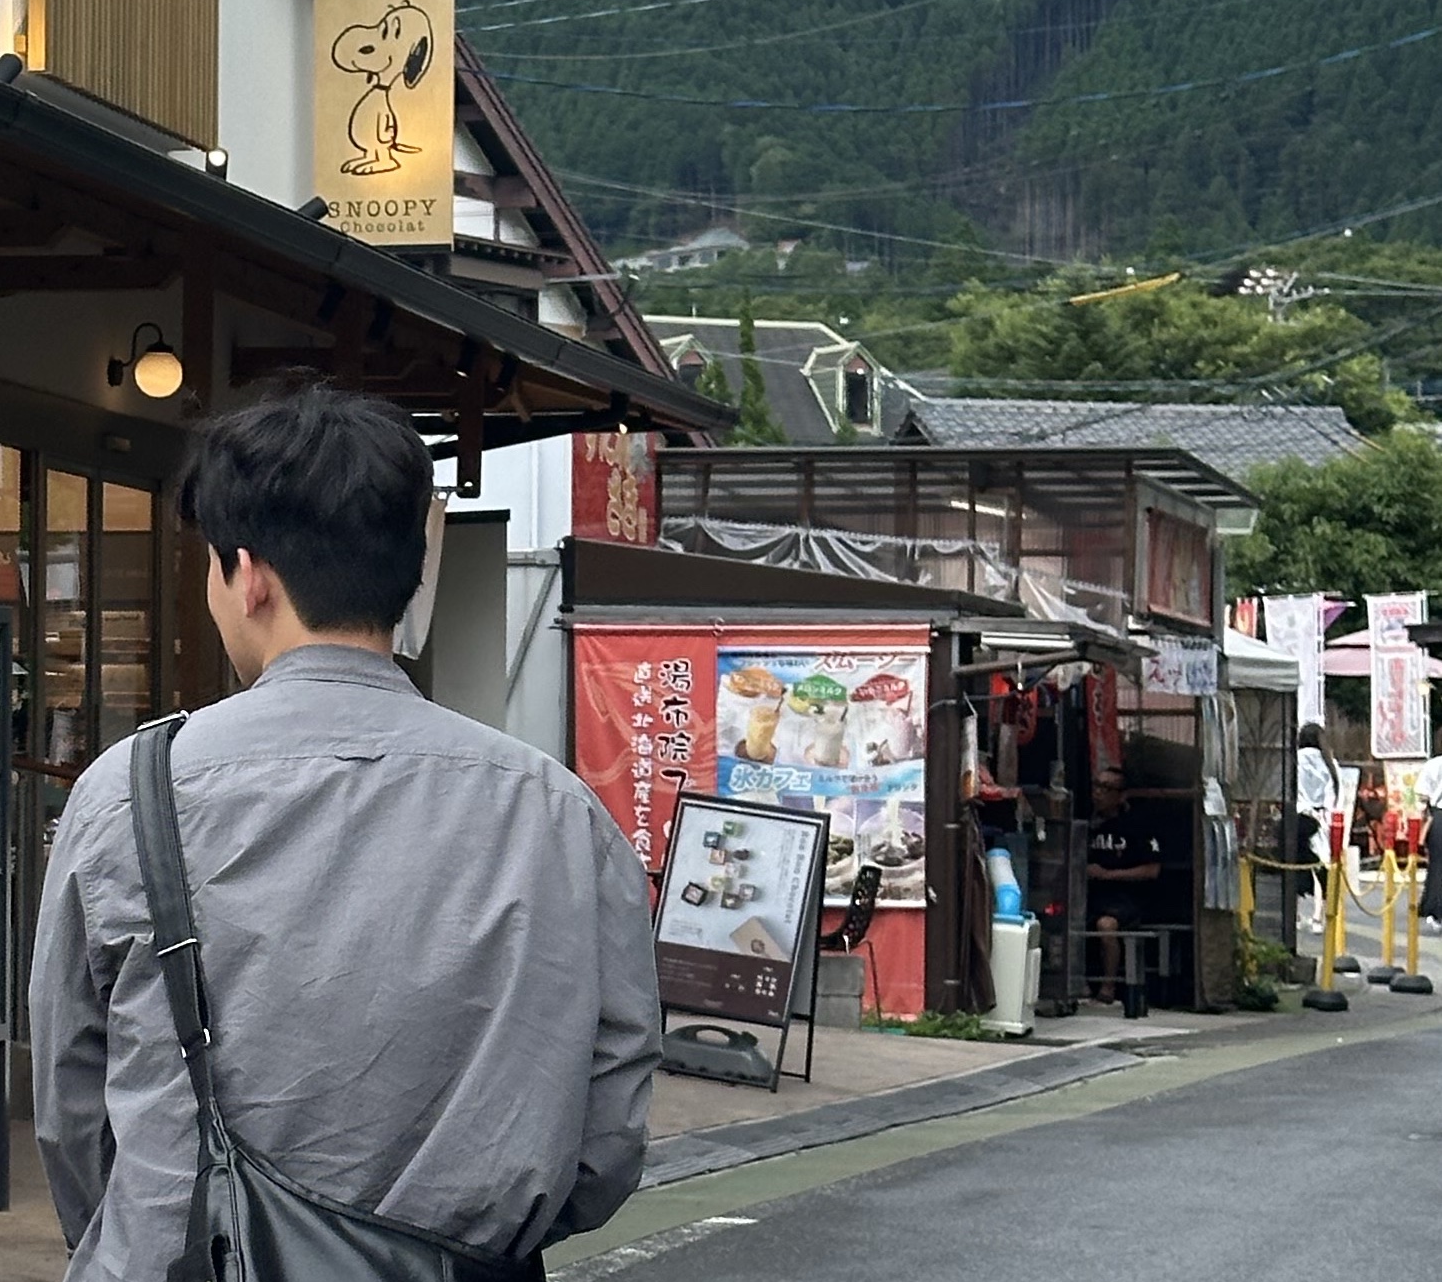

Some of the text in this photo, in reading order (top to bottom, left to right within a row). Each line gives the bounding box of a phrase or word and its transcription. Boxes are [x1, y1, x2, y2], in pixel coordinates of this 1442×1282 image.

[328, 199, 437, 218] SNOOPY
[340, 219, 425, 234] Chocolat
[730, 764, 812, 791] 氷カフェ
